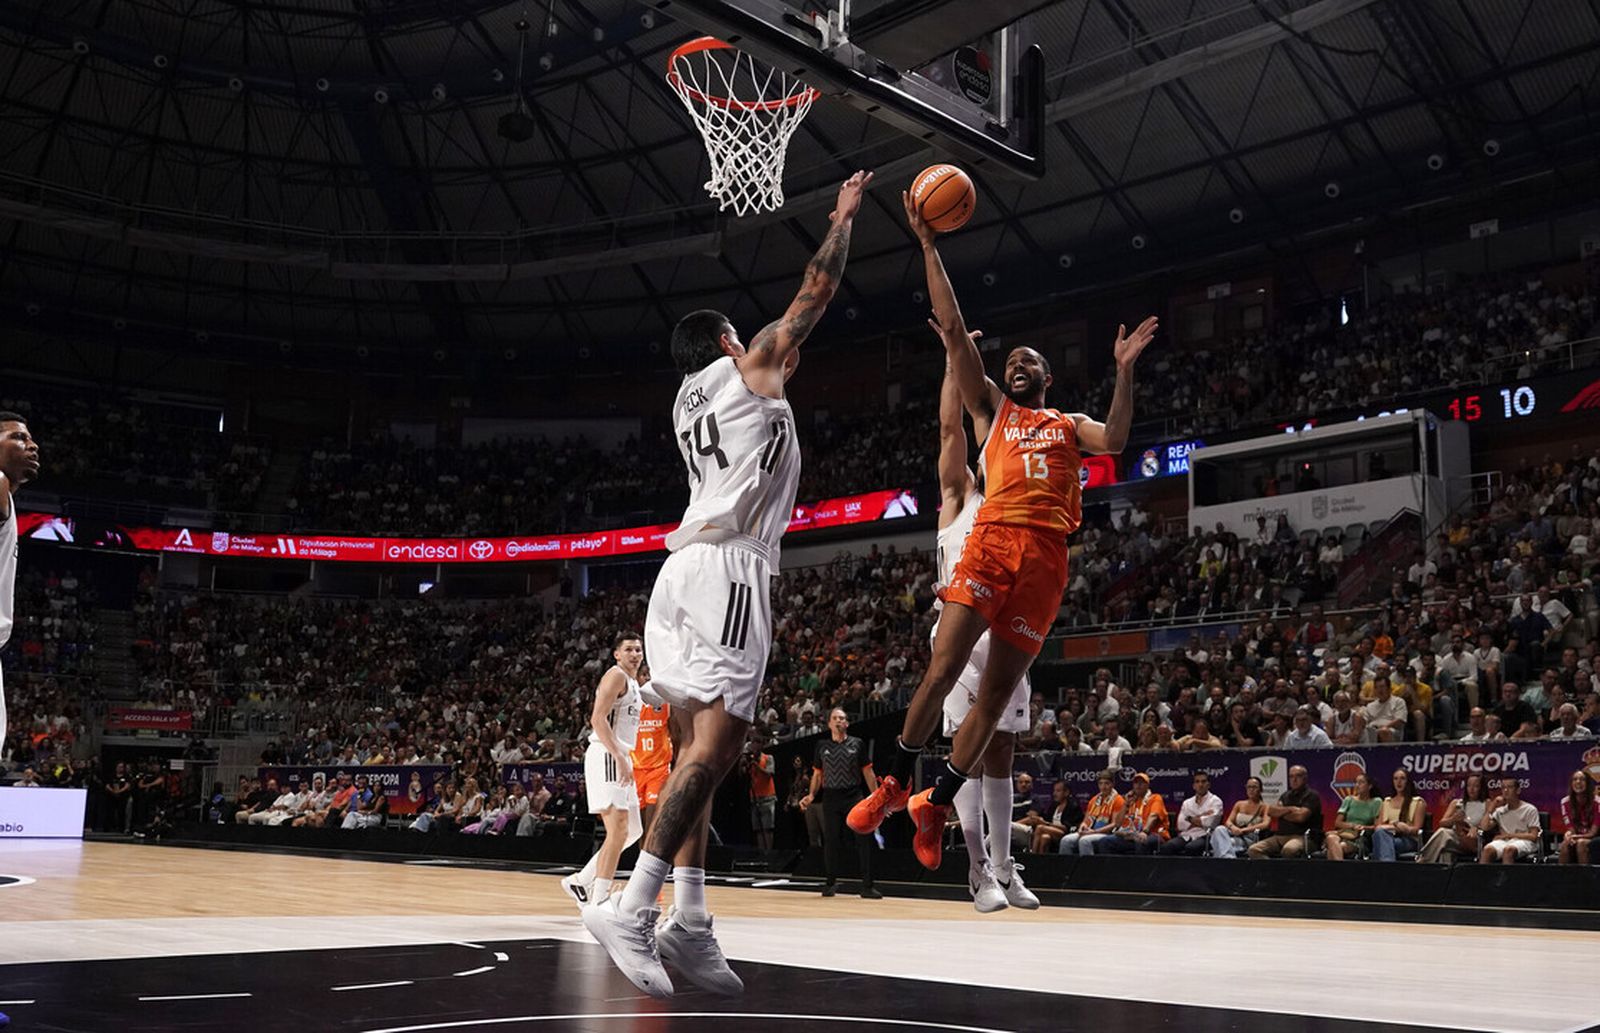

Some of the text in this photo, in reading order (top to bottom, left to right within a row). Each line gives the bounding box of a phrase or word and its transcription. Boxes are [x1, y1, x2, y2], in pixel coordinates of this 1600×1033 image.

[1448, 394, 1482, 422] 15
[1500, 385, 1536, 419] 10
[1003, 427, 1067, 444] VALENCIA
[680, 411, 730, 484] 14
[1021, 453, 1049, 479] 13
[388, 542, 458, 559] endesa
[570, 539, 602, 552] pelayo
[641, 737, 654, 751] 10
[1401, 752, 1530, 774] SUPERCOPA
